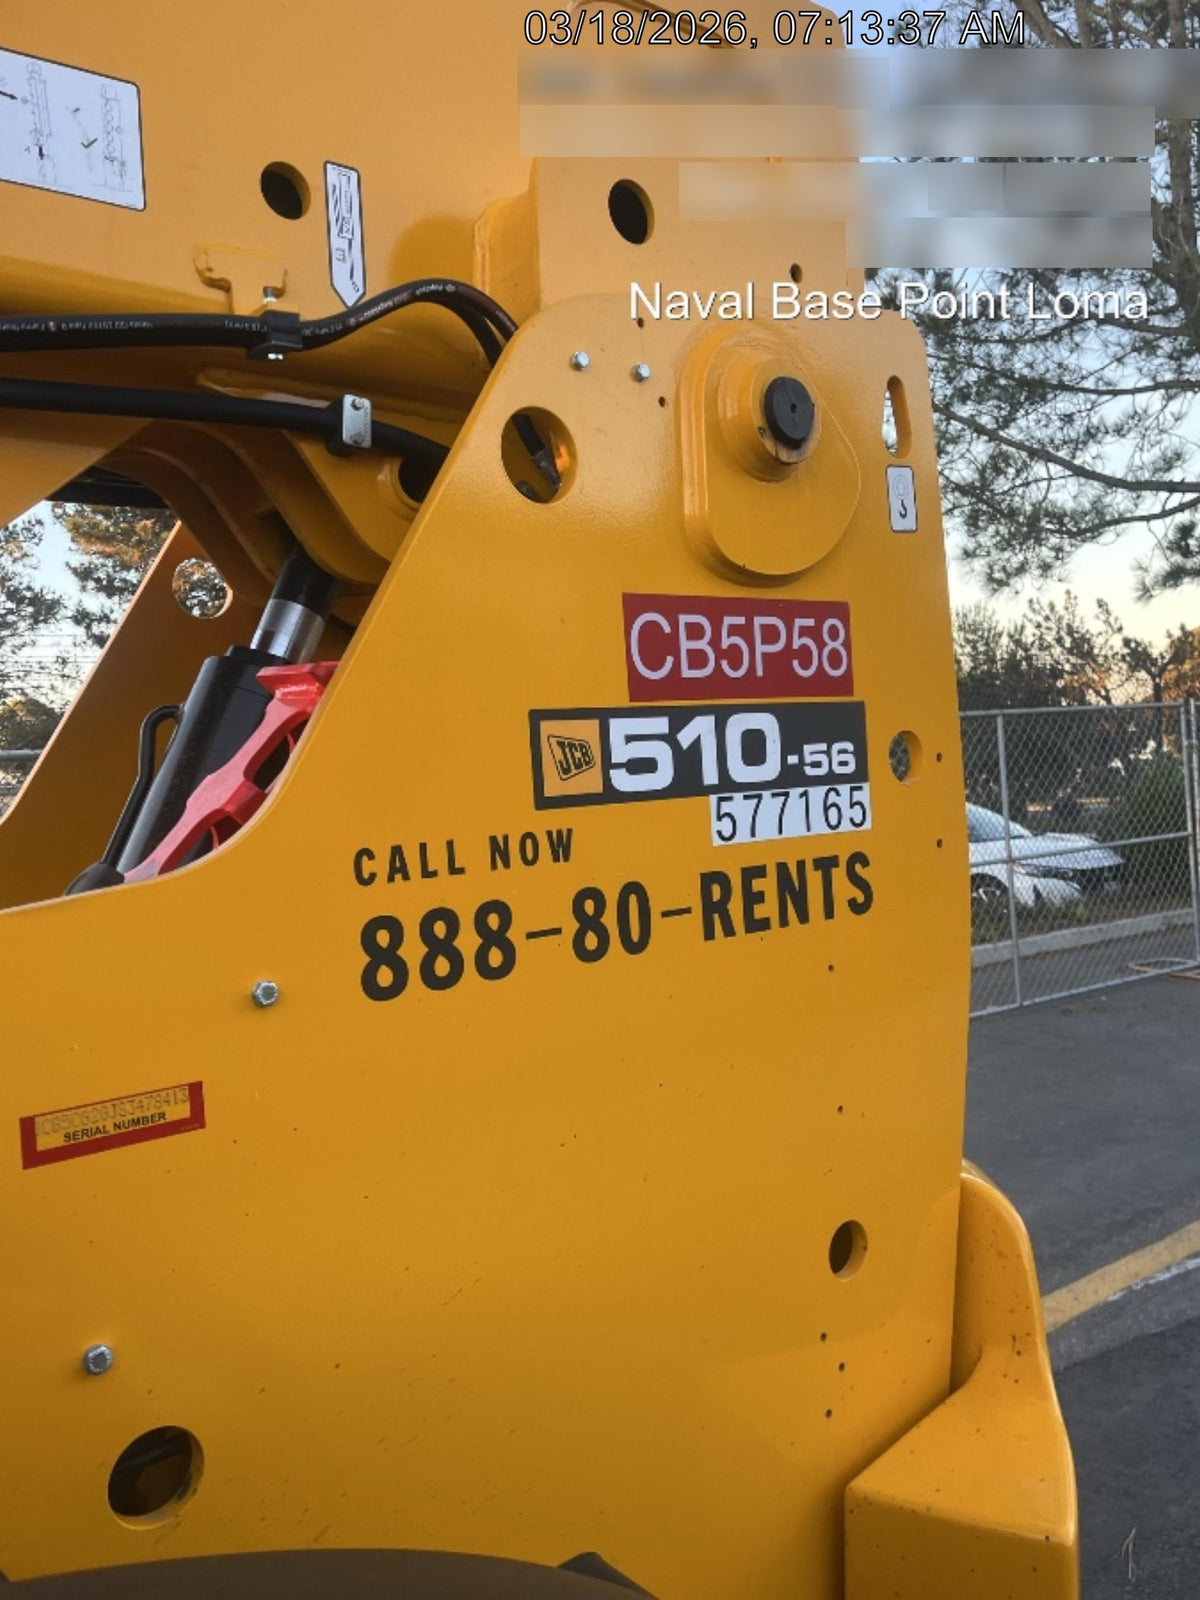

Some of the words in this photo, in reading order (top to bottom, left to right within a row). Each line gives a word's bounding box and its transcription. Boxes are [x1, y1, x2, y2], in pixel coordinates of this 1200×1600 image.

[630, 612, 849, 680] CB5P58
[554, 738, 594, 775] JCB
[608, 712, 857, 793] 510-56
[714, 785, 868, 842] 577165
[353, 838, 466, 886] CALL
[489, 828, 574, 871] NOW
[360, 850, 875, 1002] 888-80-RENTS
[63, 1125, 110, 1143] SERIAL
[112, 1110, 167, 1131] NUMBER
